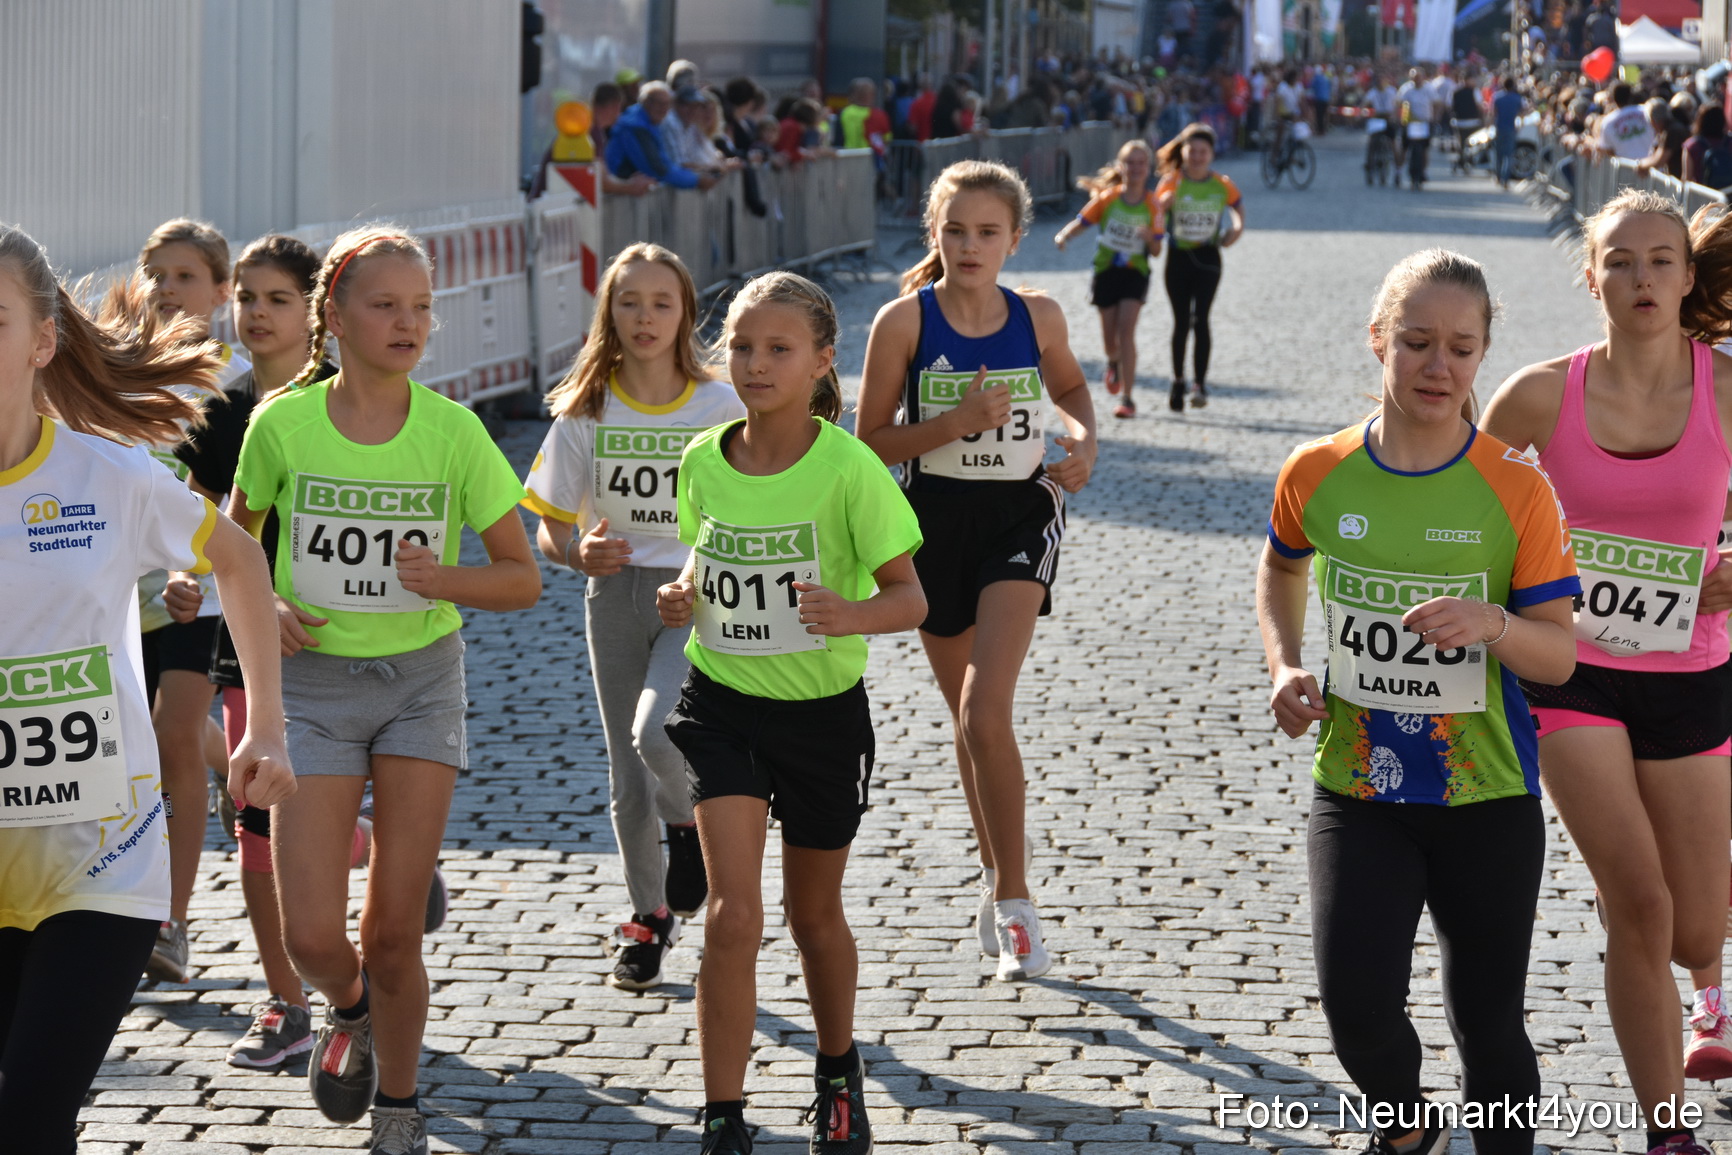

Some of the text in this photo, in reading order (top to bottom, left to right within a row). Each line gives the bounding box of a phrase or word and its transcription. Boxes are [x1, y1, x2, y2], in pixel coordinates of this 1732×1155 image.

[962, 454, 1005, 467] LISA
[304, 481, 435, 516] BOCK
[26, 500, 93, 524] 20 JAHRE
[631, 509, 679, 523] MAR
[28, 520, 106, 537] Neumarkter
[1426, 529, 1482, 543] BOCK
[29, 535, 93, 553] Stadtlauf
[700, 521, 804, 560] BOCK
[1571, 533, 1692, 581] BOCK
[344, 579, 386, 597] LILI
[702, 565, 798, 610] 4011
[722, 622, 770, 640] LENI
[1595, 626, 1640, 649] Lena
[1358, 673, 1441, 697] LAURA
[102, 711, 109, 720] J
[0, 781, 80, 807] RIAM
[87, 801, 162, 878] 14./15. September
